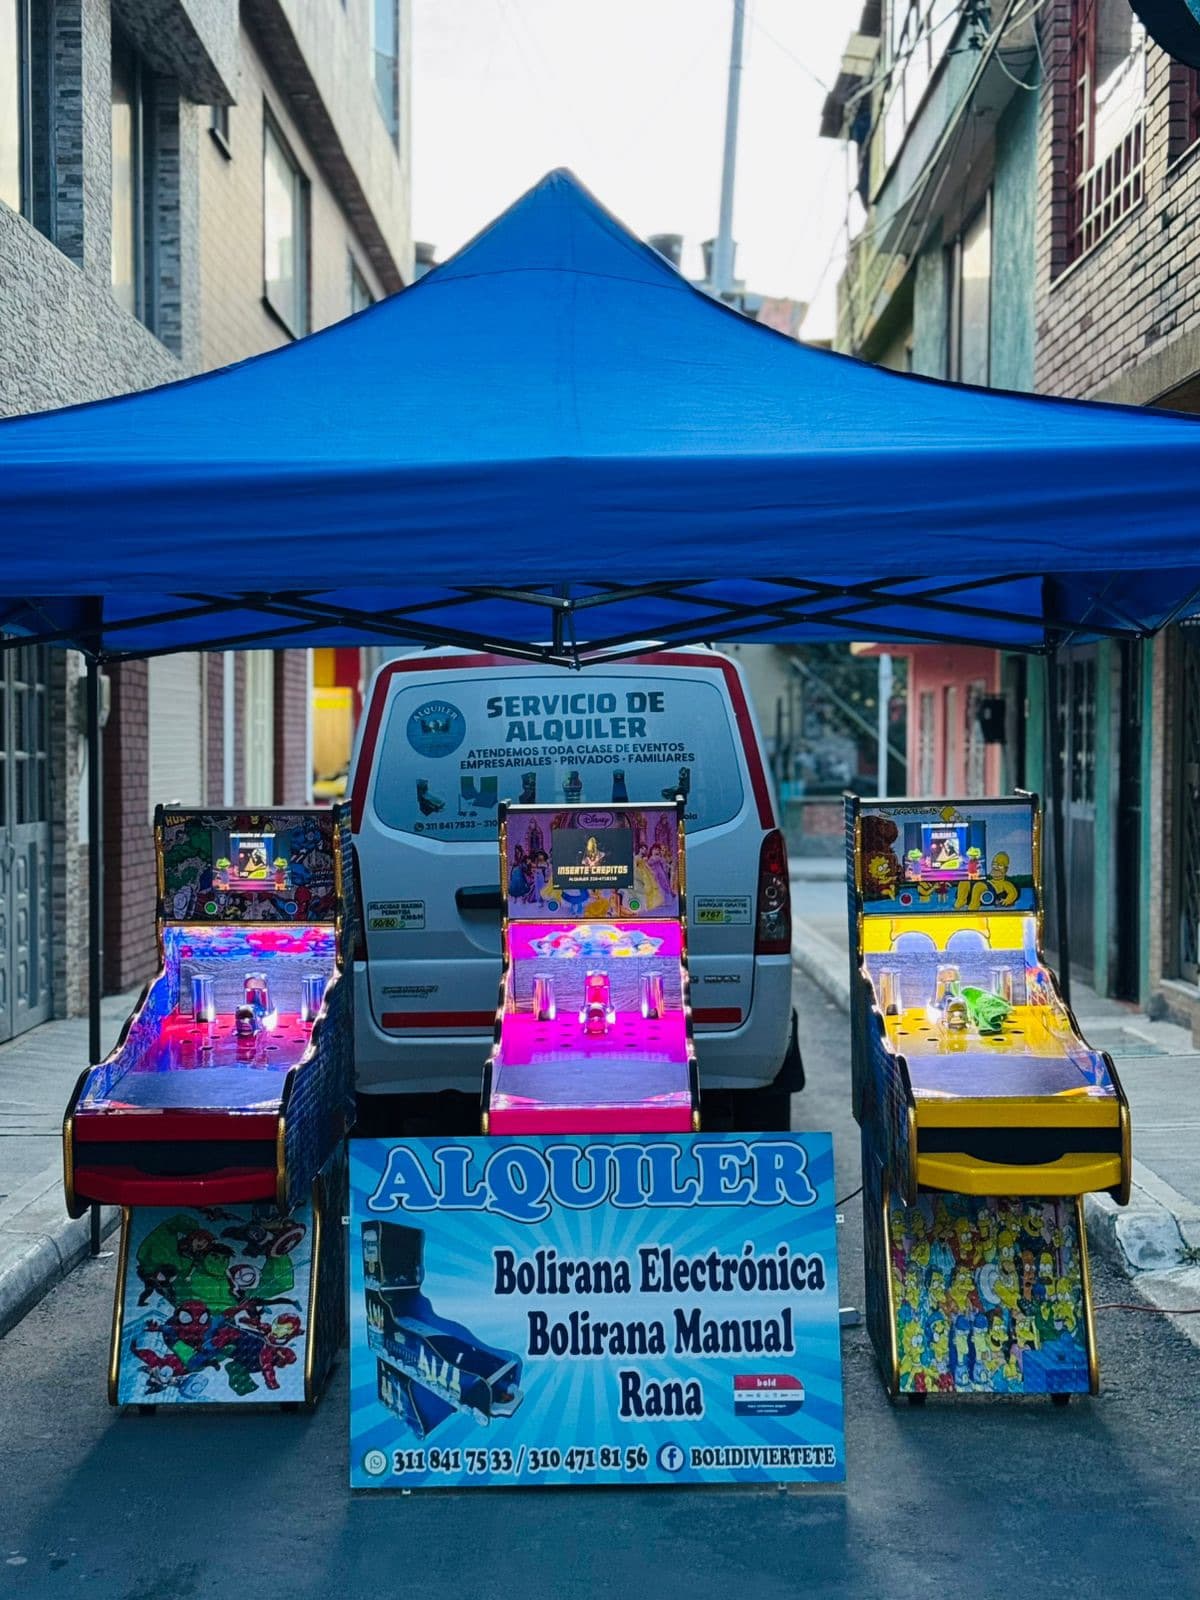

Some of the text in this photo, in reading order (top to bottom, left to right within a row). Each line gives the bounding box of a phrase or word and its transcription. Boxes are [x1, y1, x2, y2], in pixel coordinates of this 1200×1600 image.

[413, 705, 459, 722] ALQUILER
[487, 691, 665, 719] SERVICIO DE
[505, 717, 648, 743] ALQUILER
[460, 756, 552, 770] EMPRESARIALES
[560, 754, 619, 765] PRIVADOS
[628, 752, 695, 763] FAMILIARES
[467, 742, 685, 759] ATENDEMOS TODA CLASE DE EVENTOS
[557, 866, 590, 875] INSERTE
[368, 1141, 818, 1223] ALQUILER
[493, 1244, 826, 1295] Bolirana Electrónica
[526, 1306, 795, 1356] Bolirana Manual
[619, 1370, 704, 1418] Rana
[756, 1378, 777, 1388] bold
[392, 1450, 425, 1473] 311
[429, 1449, 461, 1472] 841
[528, 1449, 561, 1472] 310
[564, 1448, 595, 1472] 471
[600, 1448, 622, 1468] 81
[626, 1446, 649, 1469] 56
[691, 1447, 835, 1467] BOLIDIVIERTETE
